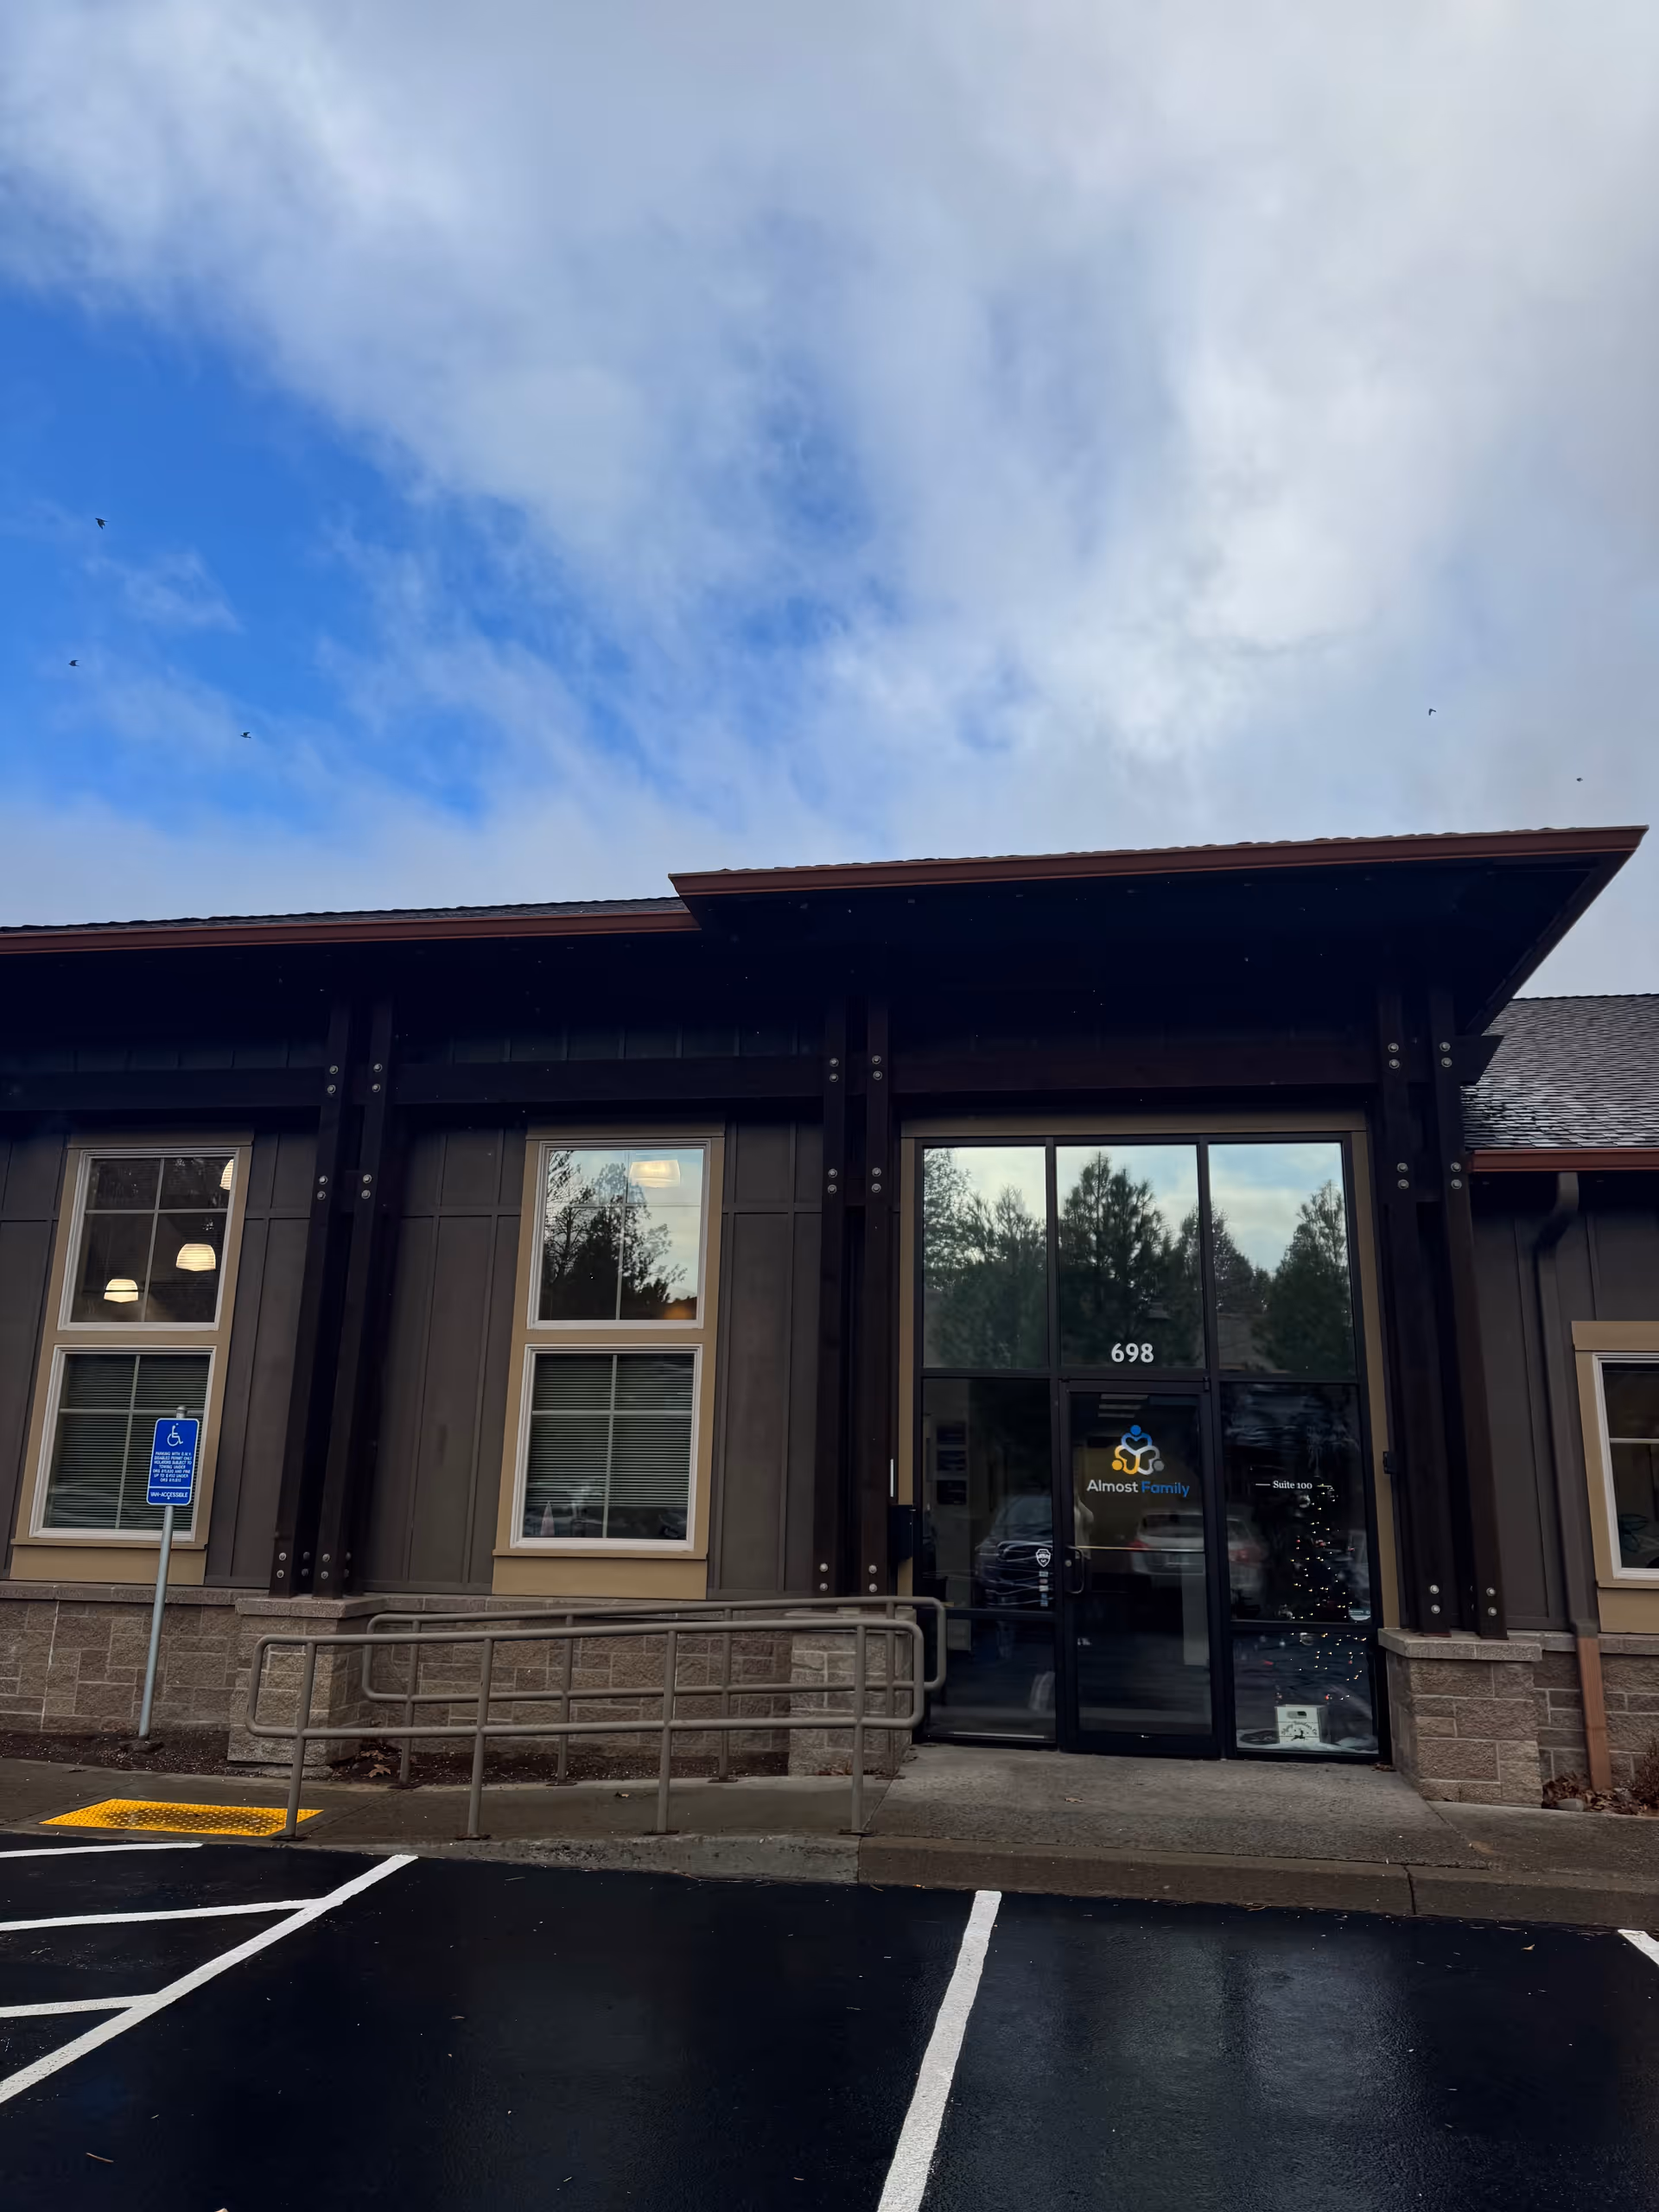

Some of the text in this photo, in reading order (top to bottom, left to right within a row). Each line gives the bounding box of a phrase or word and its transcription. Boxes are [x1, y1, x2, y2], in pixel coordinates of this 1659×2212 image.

[1111, 1343, 1154, 1363] 698
[1086, 1479, 1190, 1497] Almost Family
[1273, 1480, 1295, 1489] Suite
